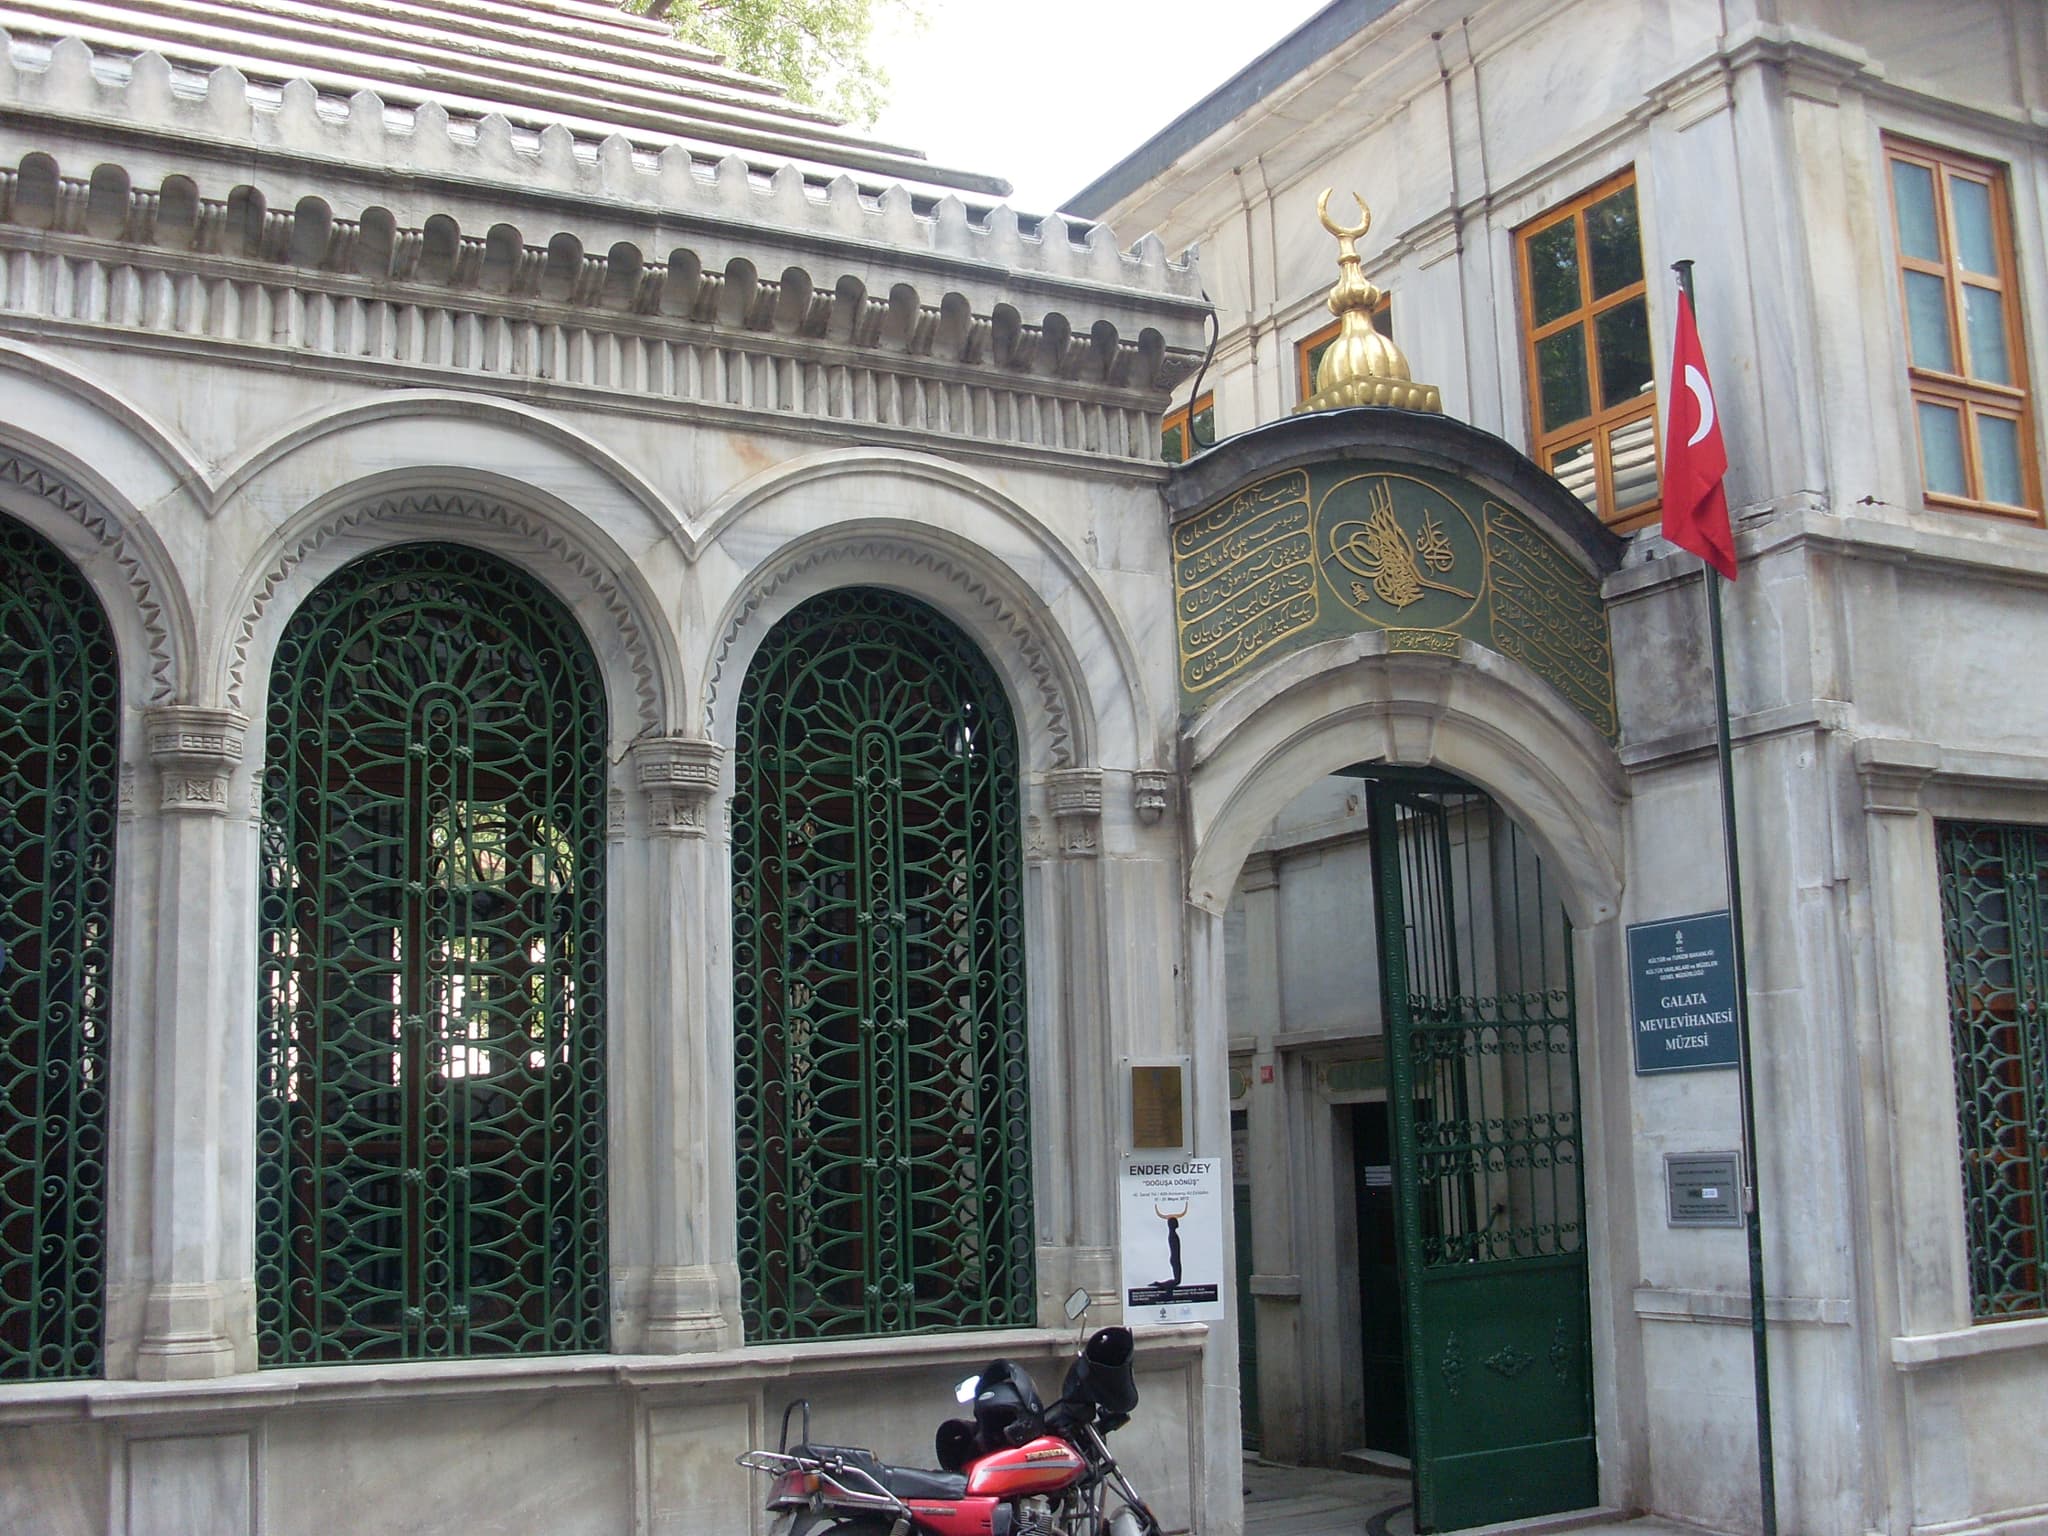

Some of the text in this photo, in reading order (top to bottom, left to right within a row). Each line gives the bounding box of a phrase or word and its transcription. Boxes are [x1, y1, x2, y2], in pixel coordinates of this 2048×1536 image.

[1661, 993, 1707, 1008] GALATA
[1640, 1008, 1733, 1032] MEVLEVİHANESİ
[1665, 1032, 1709, 1050] MÜZESİ
[1129, 1162, 1211, 1176] ENDER GÜZEY
